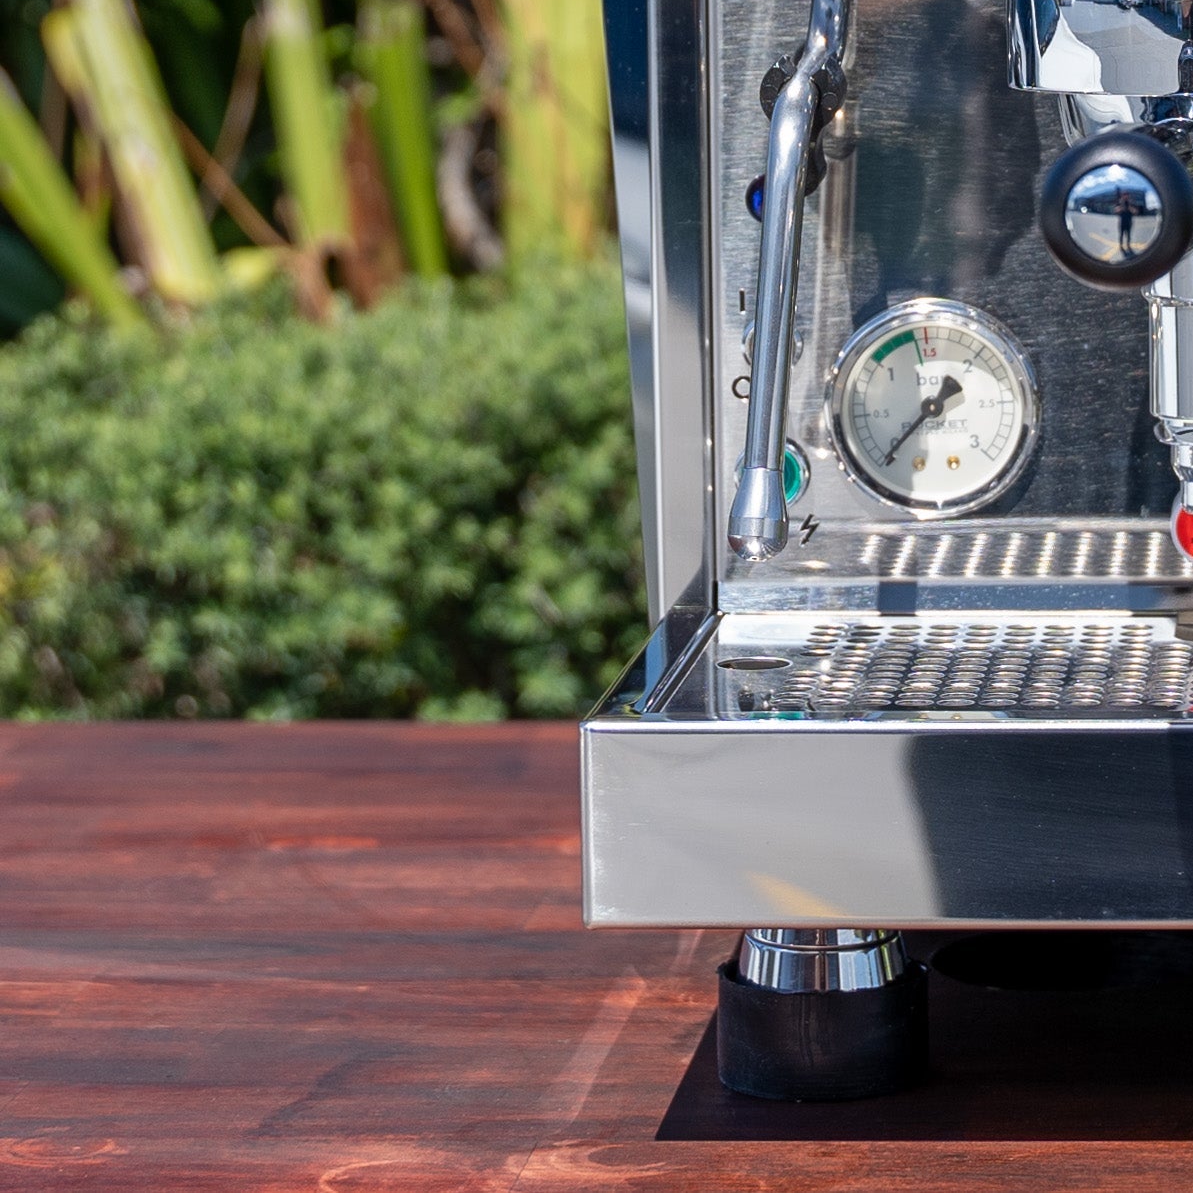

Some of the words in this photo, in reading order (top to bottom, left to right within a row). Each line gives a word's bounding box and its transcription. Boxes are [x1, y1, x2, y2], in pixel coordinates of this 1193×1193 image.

[922, 348, 937, 358] 1.5
[963, 359, 973, 374] 2
[887, 368, 895, 381] 1
[916, 372, 944, 386] ba
[979, 399, 996, 408] 2.5
[873, 409, 889, 418] 0.5
[970, 434, 980, 448] 3
